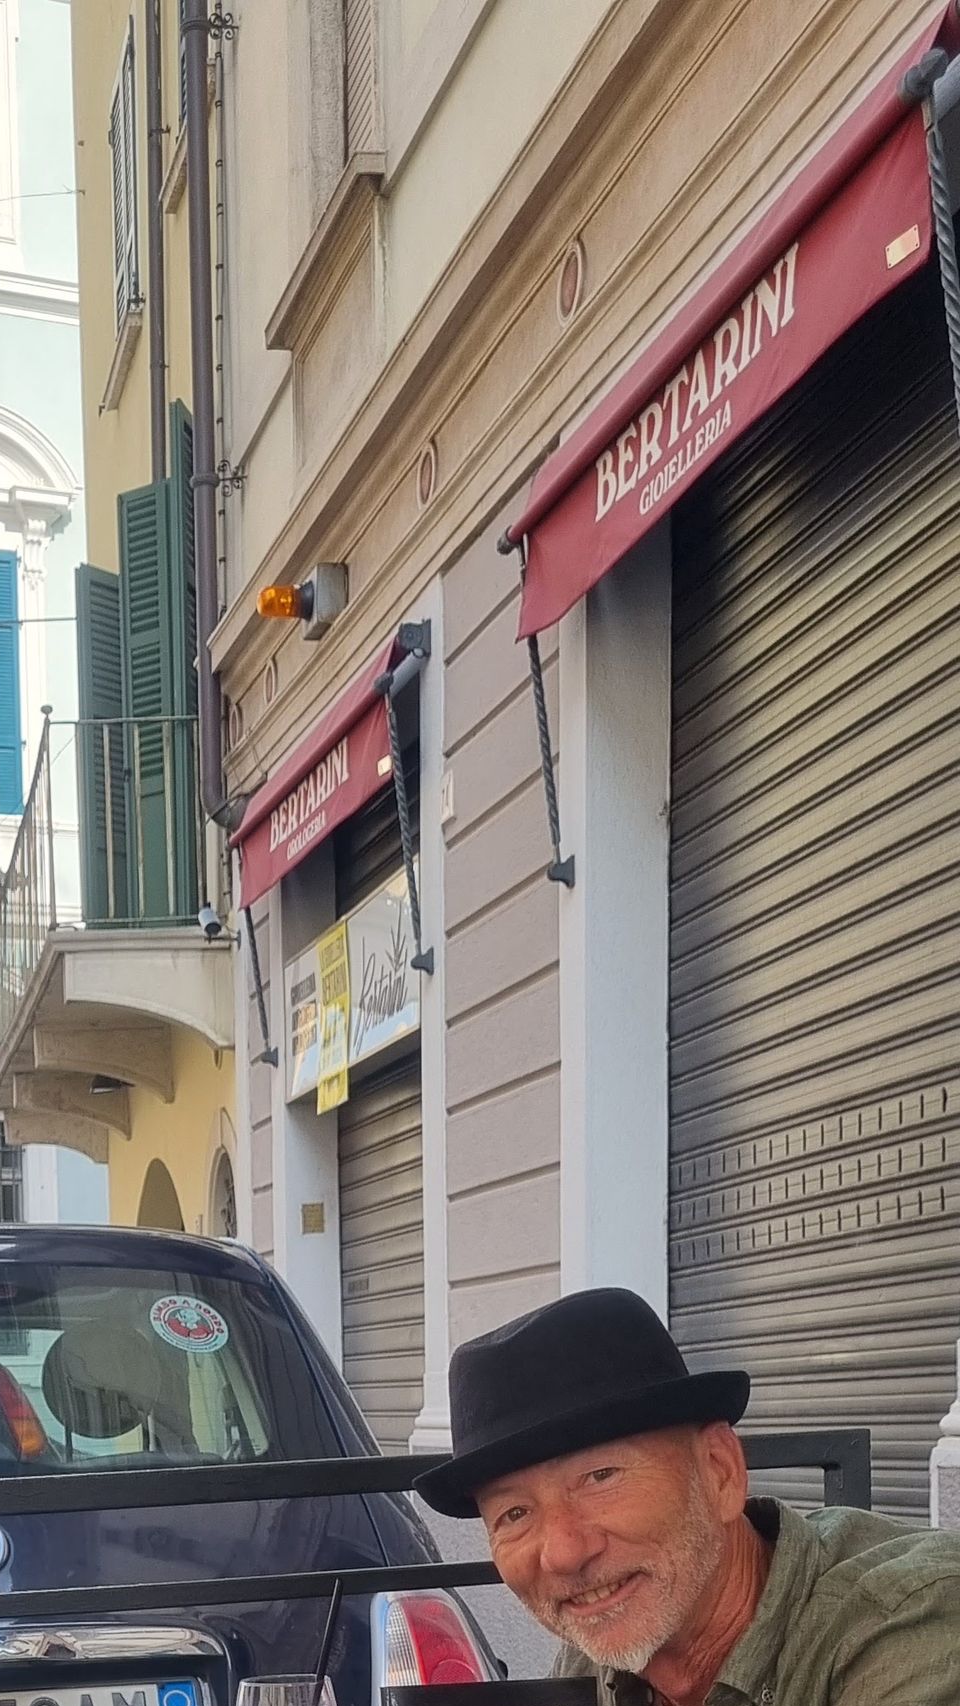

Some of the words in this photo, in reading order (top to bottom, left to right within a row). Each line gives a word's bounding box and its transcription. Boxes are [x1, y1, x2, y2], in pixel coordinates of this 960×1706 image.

[594, 242, 800, 523] BERTARINI
[639, 400, 732, 516] GIOIELLERIA
[269, 736, 350, 853] BERTARINI
[182, 1299, 191, 1307] A
[195, 1302, 225, 1334] BORDO
